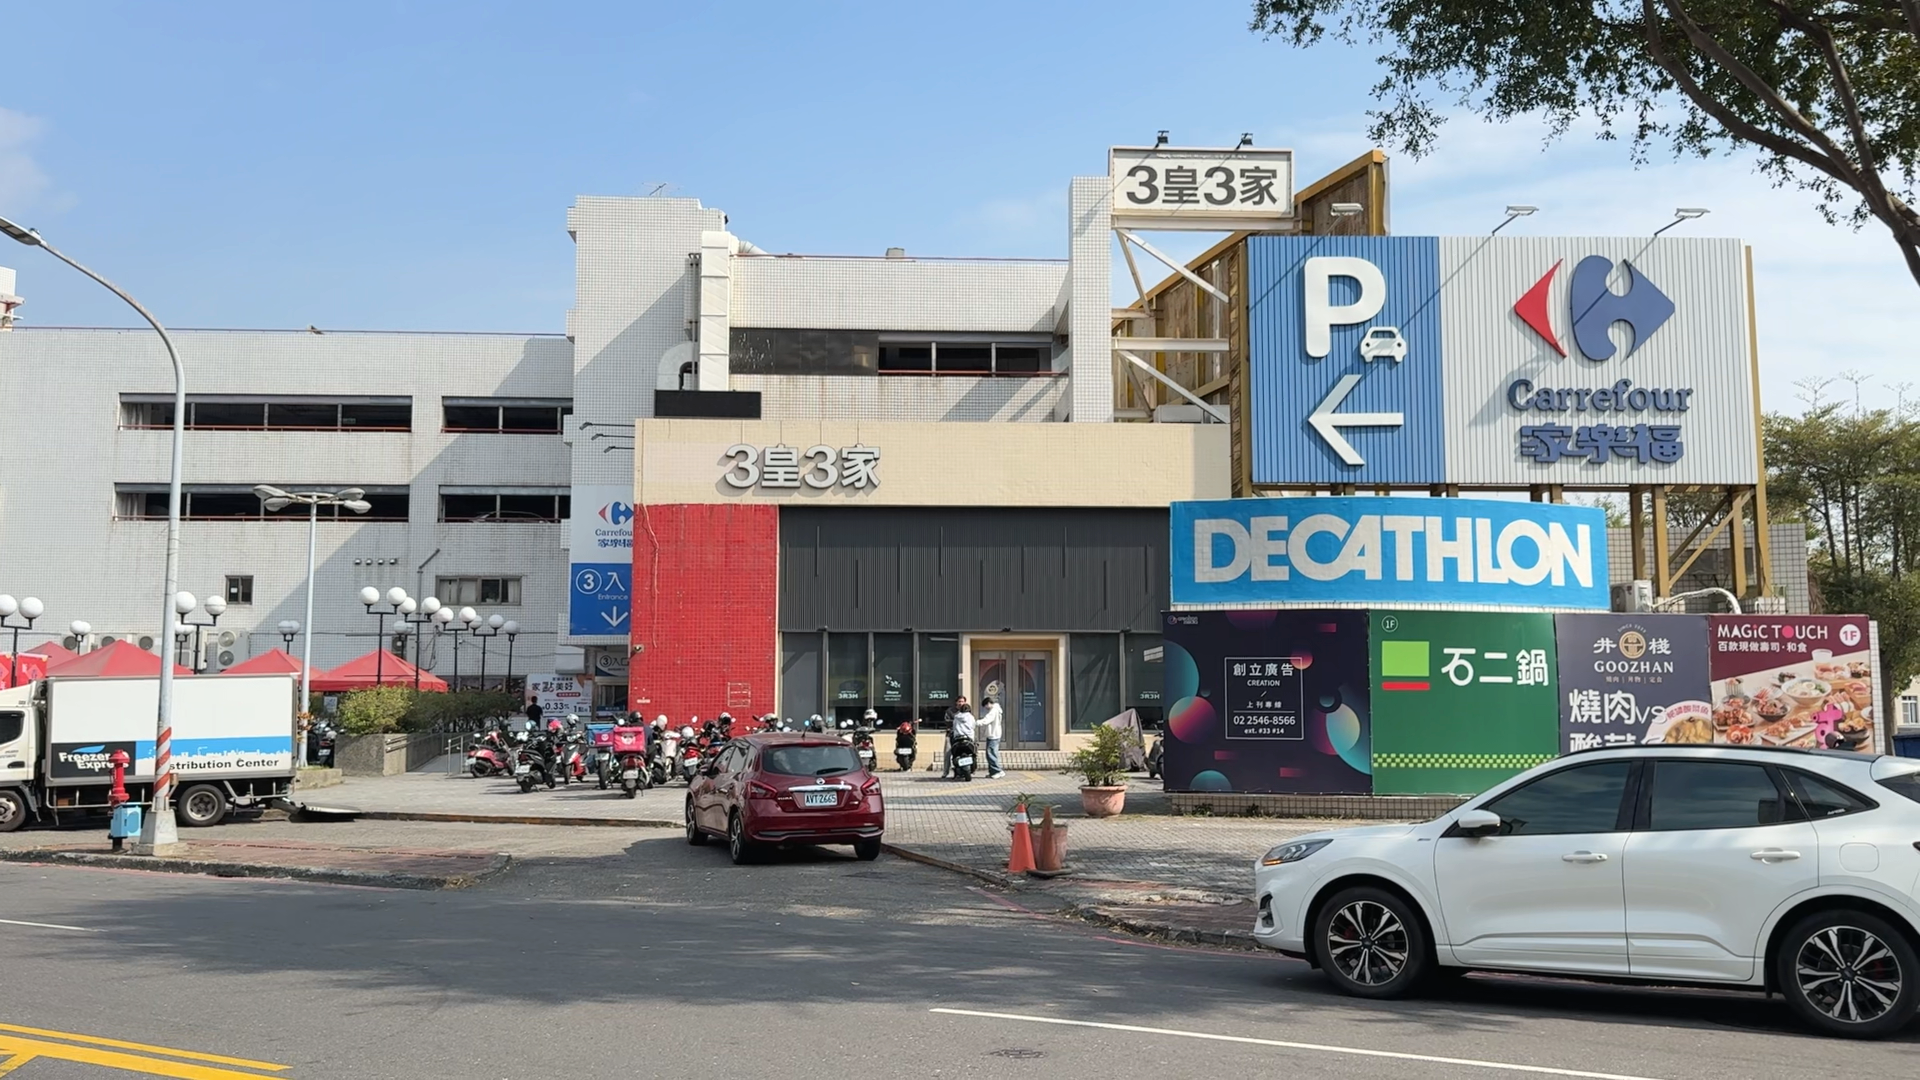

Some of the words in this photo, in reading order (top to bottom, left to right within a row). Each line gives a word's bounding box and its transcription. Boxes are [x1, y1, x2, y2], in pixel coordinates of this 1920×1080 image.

[1126, 165, 1278, 206] 3皇3家
[1304, 256, 1386, 358] P
[1508, 377, 1693, 412] Carrefour
[1520, 423, 1684, 464] 家樂福
[725, 443, 881, 489] 3皇3家
[595, 528, 633, 537] Carrefou
[1194, 513, 1594, 588] DECATHLON
[1385, 620, 1395, 629] 1F
[1842, 630, 1857, 641] 1F
[1593, 637, 1617, 654] 井
[1233, 663, 1294, 677] 創立廣告
[1441, 648, 1549, 686] 石二鍋
[1594, 660, 1674, 673] GOOZHAN
[1247, 679, 1280, 687] CREATION
[1233, 716, 1245, 725] 02
[1247, 716, 1295, 725] 2546-8566
[58, 751, 111, 763] Freezer
[77, 760, 129, 772] Expres
[170, 759, 231, 770] stribution
[237, 758, 279, 768] Center
